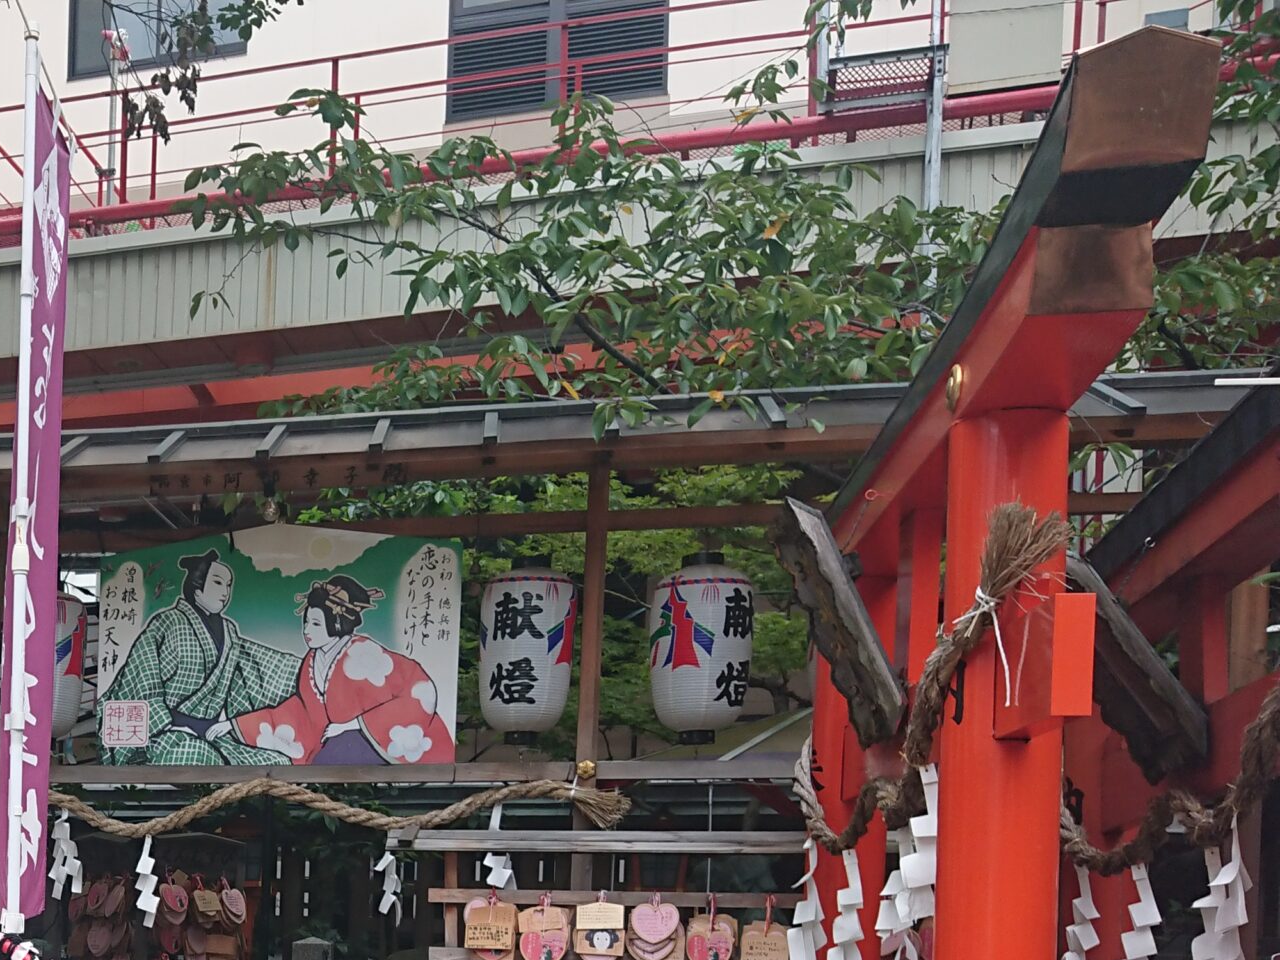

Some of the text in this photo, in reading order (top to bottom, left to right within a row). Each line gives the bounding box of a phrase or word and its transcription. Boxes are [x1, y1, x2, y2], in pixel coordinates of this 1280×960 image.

[101, 586, 120, 674] お初天神
[403, 567, 420, 656] なりにけり
[418, 546, 437, 646] 恋の手本と
